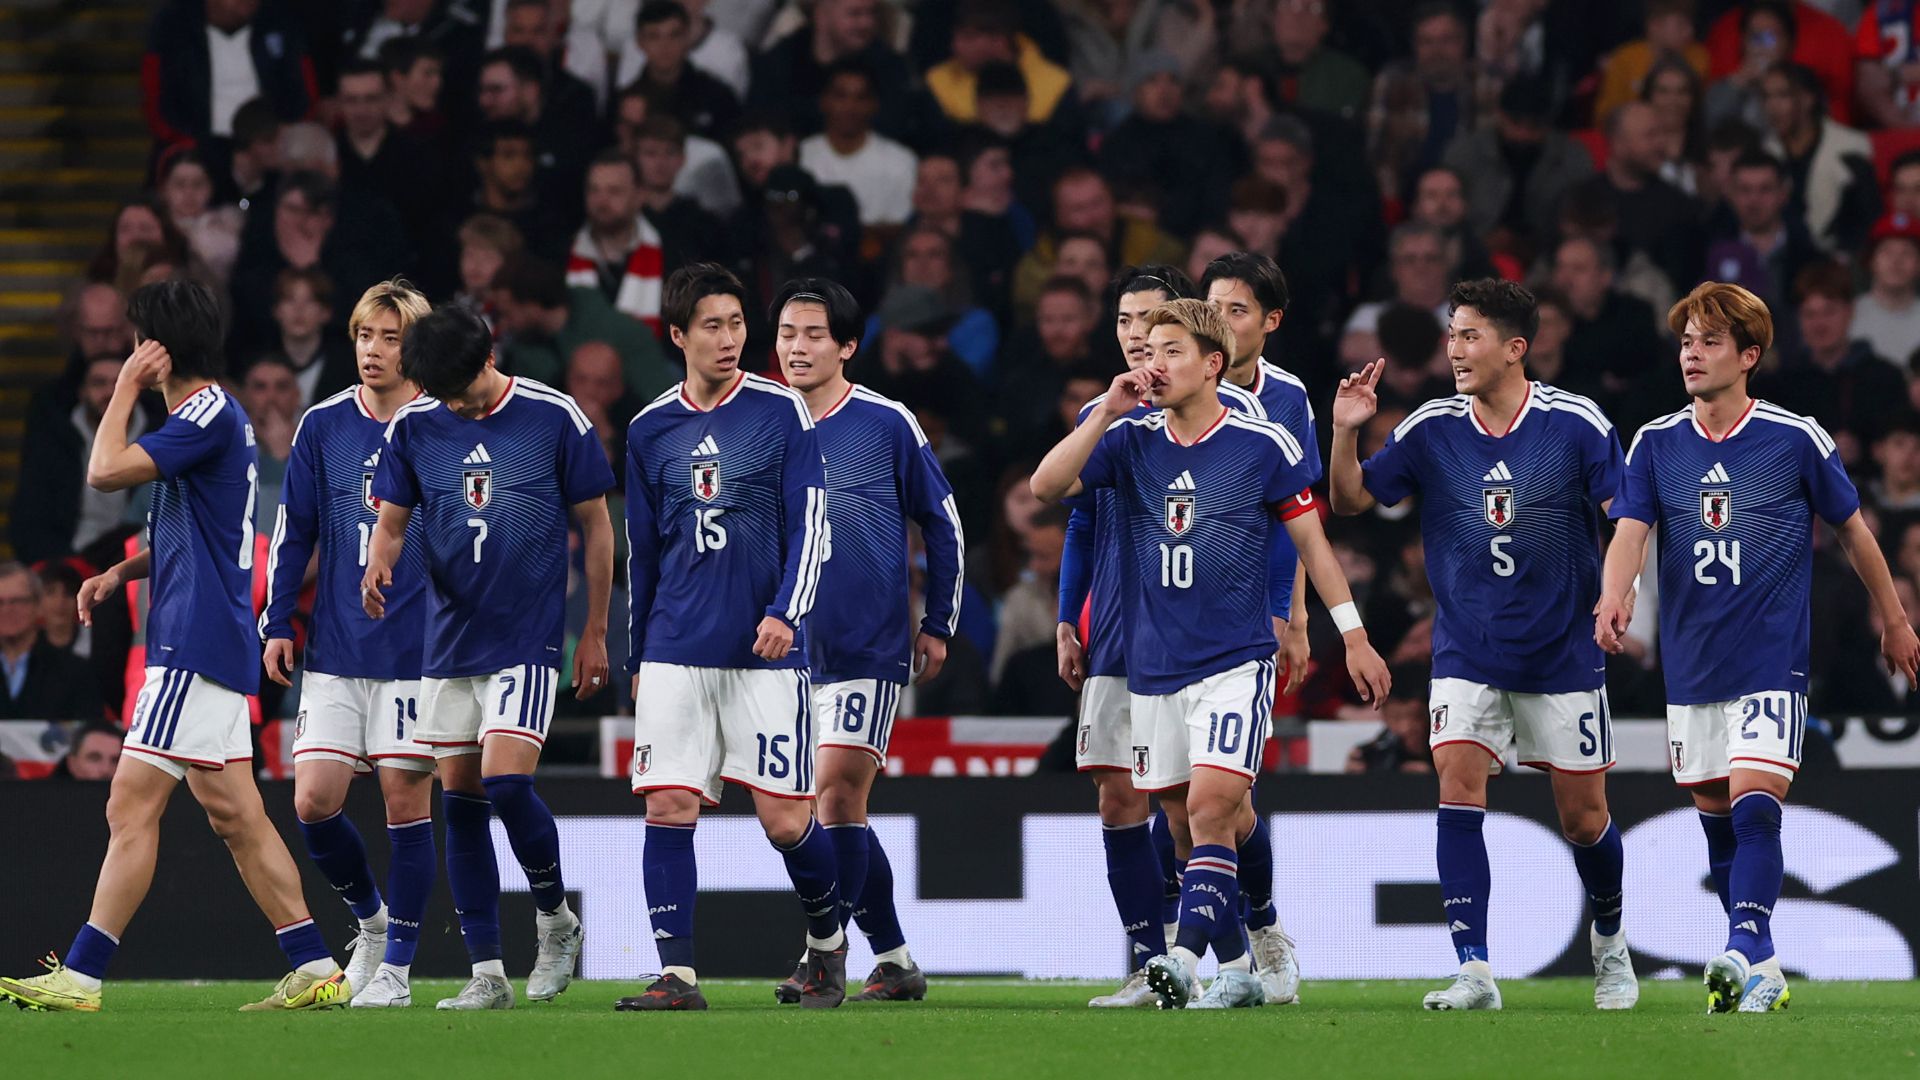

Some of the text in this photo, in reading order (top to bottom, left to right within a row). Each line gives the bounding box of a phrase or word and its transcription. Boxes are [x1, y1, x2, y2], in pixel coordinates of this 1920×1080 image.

[239, 462, 259, 570] 1
[694, 508, 727, 553] 15
[358, 522, 379, 567] 1
[467, 518, 488, 564] 7
[1490, 535, 1515, 577] 5
[1159, 542, 1194, 589] 10
[1693, 540, 1741, 586] 24
[498, 675, 516, 716] 7
[832, 692, 867, 733] 18
[1207, 712, 1243, 755] 10
[1579, 712, 1597, 757] 5
[1741, 697, 1786, 740] 24
[757, 732, 790, 779] 15
[649, 904, 677, 915] PAN
[1188, 883, 1228, 907] JAPAN
[1443, 897, 1472, 908] PAN
[1734, 901, 1772, 916] JAPAN
[1125, 919, 1149, 932] PAN
